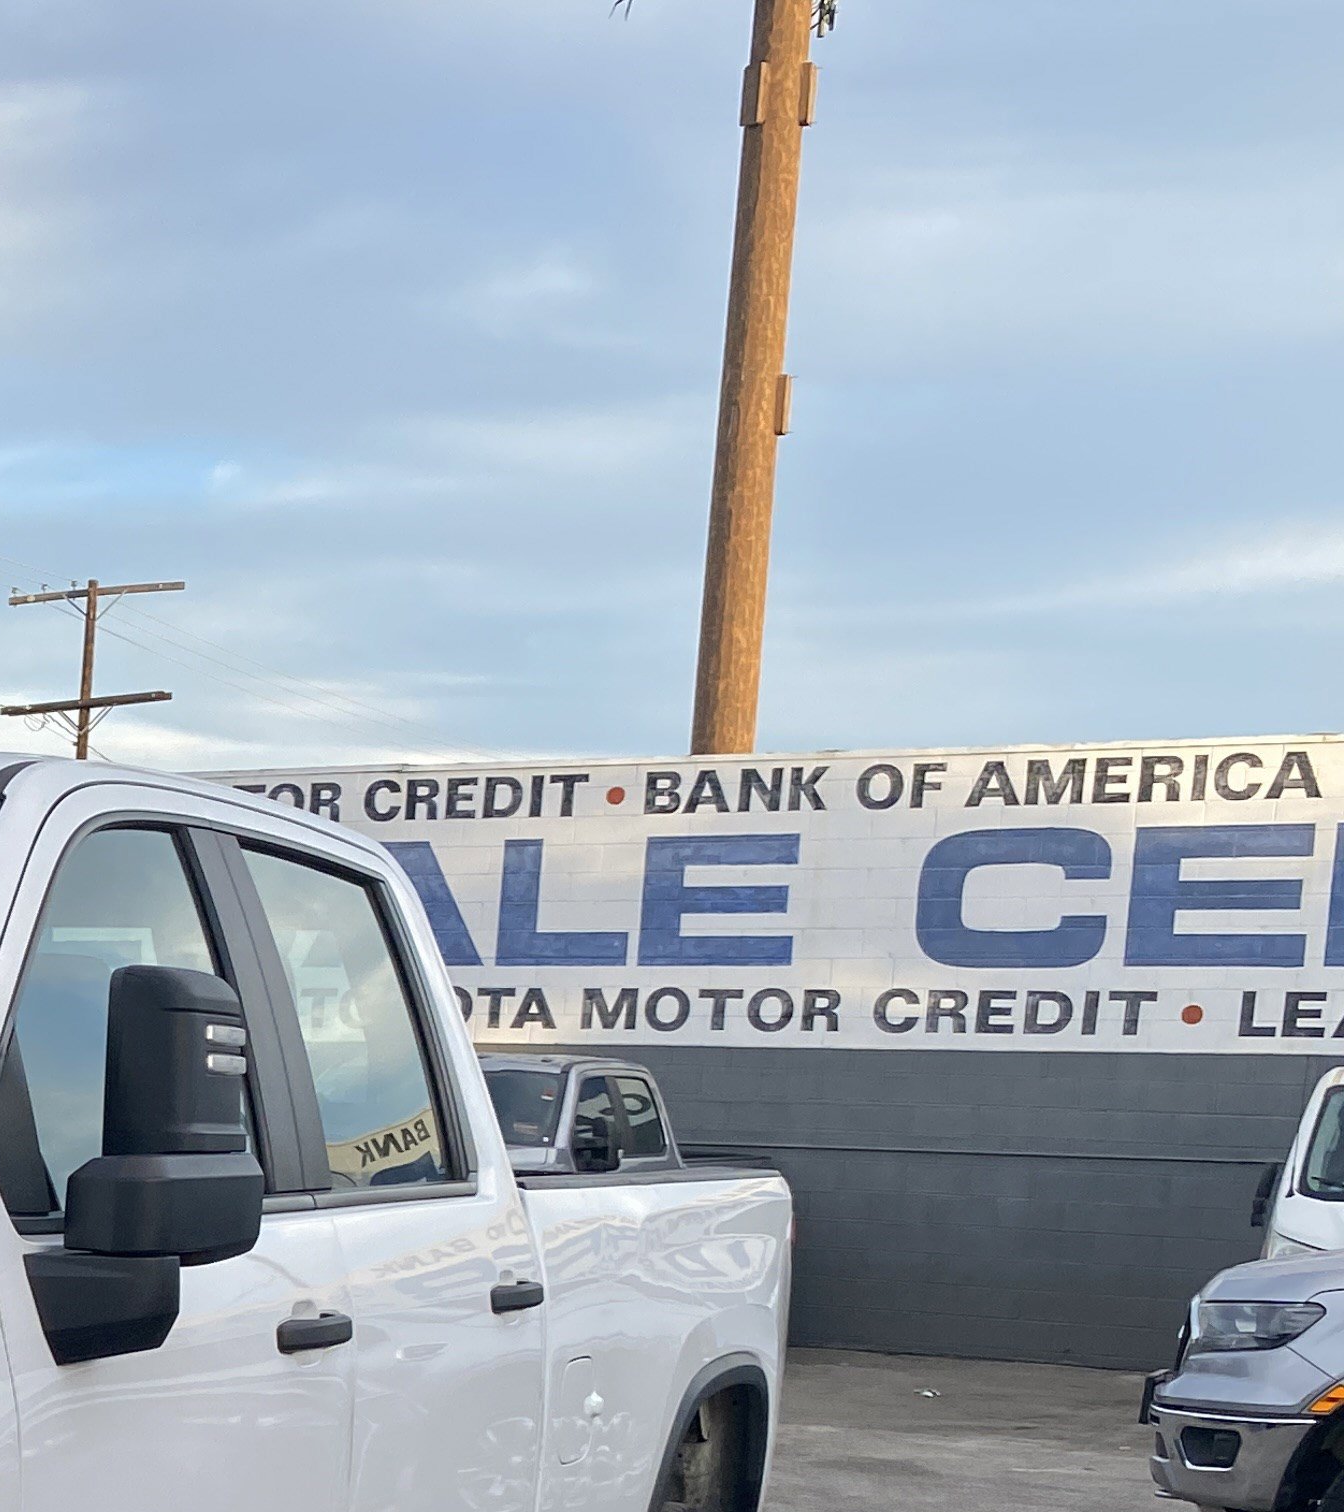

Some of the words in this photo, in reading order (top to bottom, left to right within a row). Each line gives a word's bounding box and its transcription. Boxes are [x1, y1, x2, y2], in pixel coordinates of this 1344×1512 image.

[233, 781, 341, 822] OR
[363, 773, 590, 822] CREDIT
[643, 765, 830, 815] BANK
[856, 762, 948, 811] OF
[964, 751, 1322, 809] AMERICA
[915, 823, 1344, 969] CE
[580, 986, 842, 1033] MOTOR
[873, 988, 1158, 1036] CREDIT
[1238, 990, 1344, 1039] LE
